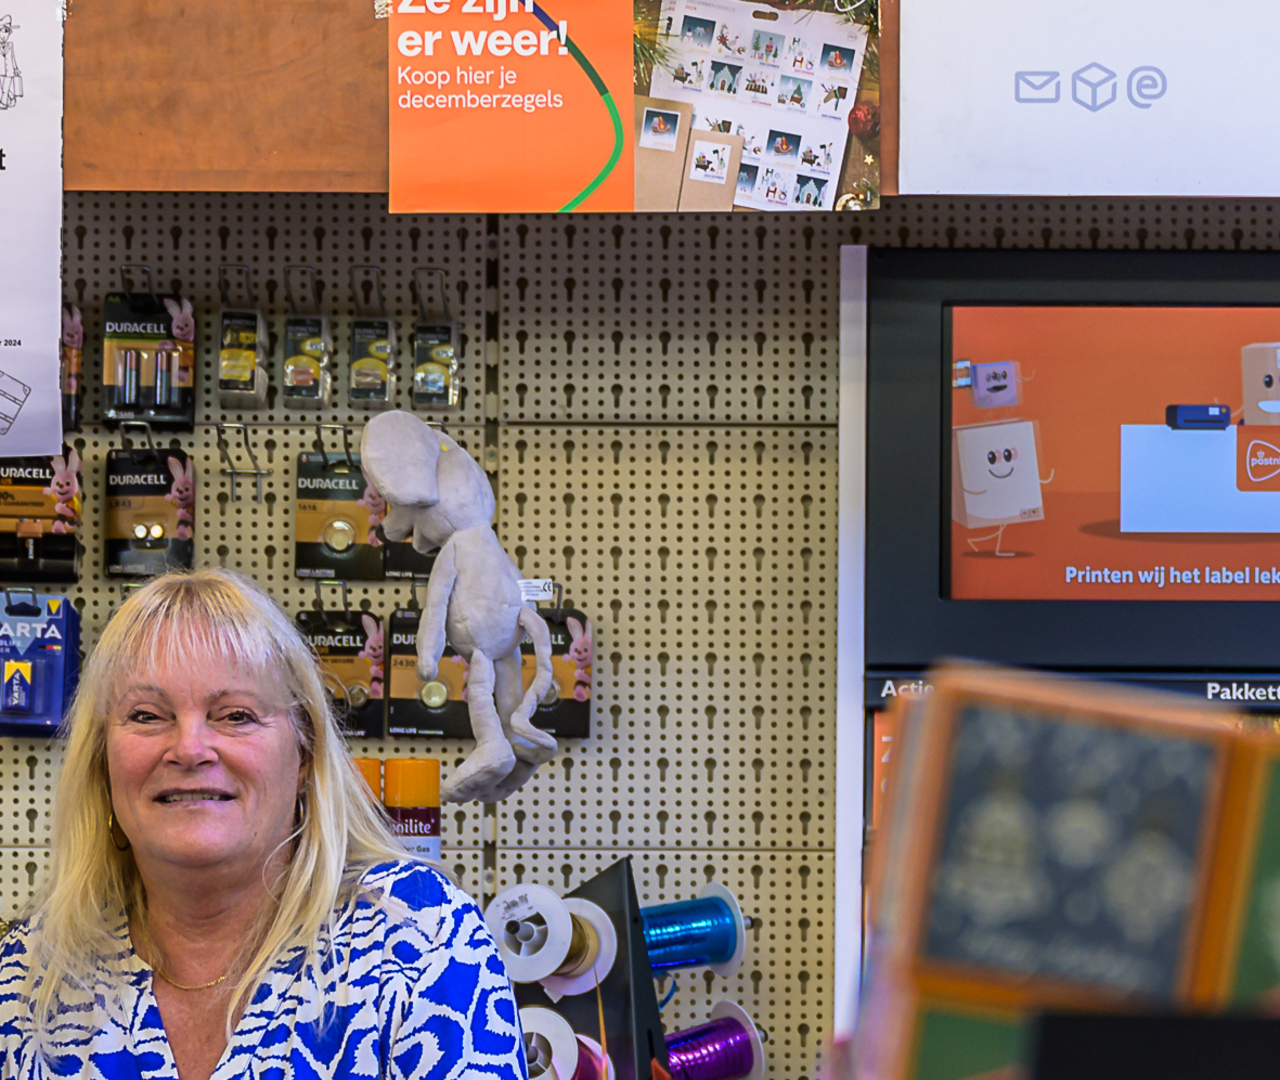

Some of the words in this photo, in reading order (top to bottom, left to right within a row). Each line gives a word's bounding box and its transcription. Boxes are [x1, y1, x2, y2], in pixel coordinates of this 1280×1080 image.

[397, 30, 442, 56] er
[451, 20, 569, 56] weer!
[397, 66, 450, 89] Koop
[457, 66, 494, 84] hier
[498, 66, 517, 89] je
[397, 90, 563, 113] decemberzegels
[106, 322, 167, 334] DURACELL
[109, 474, 167, 485] DURACELL
[298, 478, 359, 490] DURACELL
[1065, 566, 1134, 584] Printen
[1137, 566, 1167, 588] wij
[1169, 567, 1200, 584] het
[1205, 566, 1251, 584] label
[392, 659, 416, 667] 2430
[12, 672, 20, 706] VARTA
